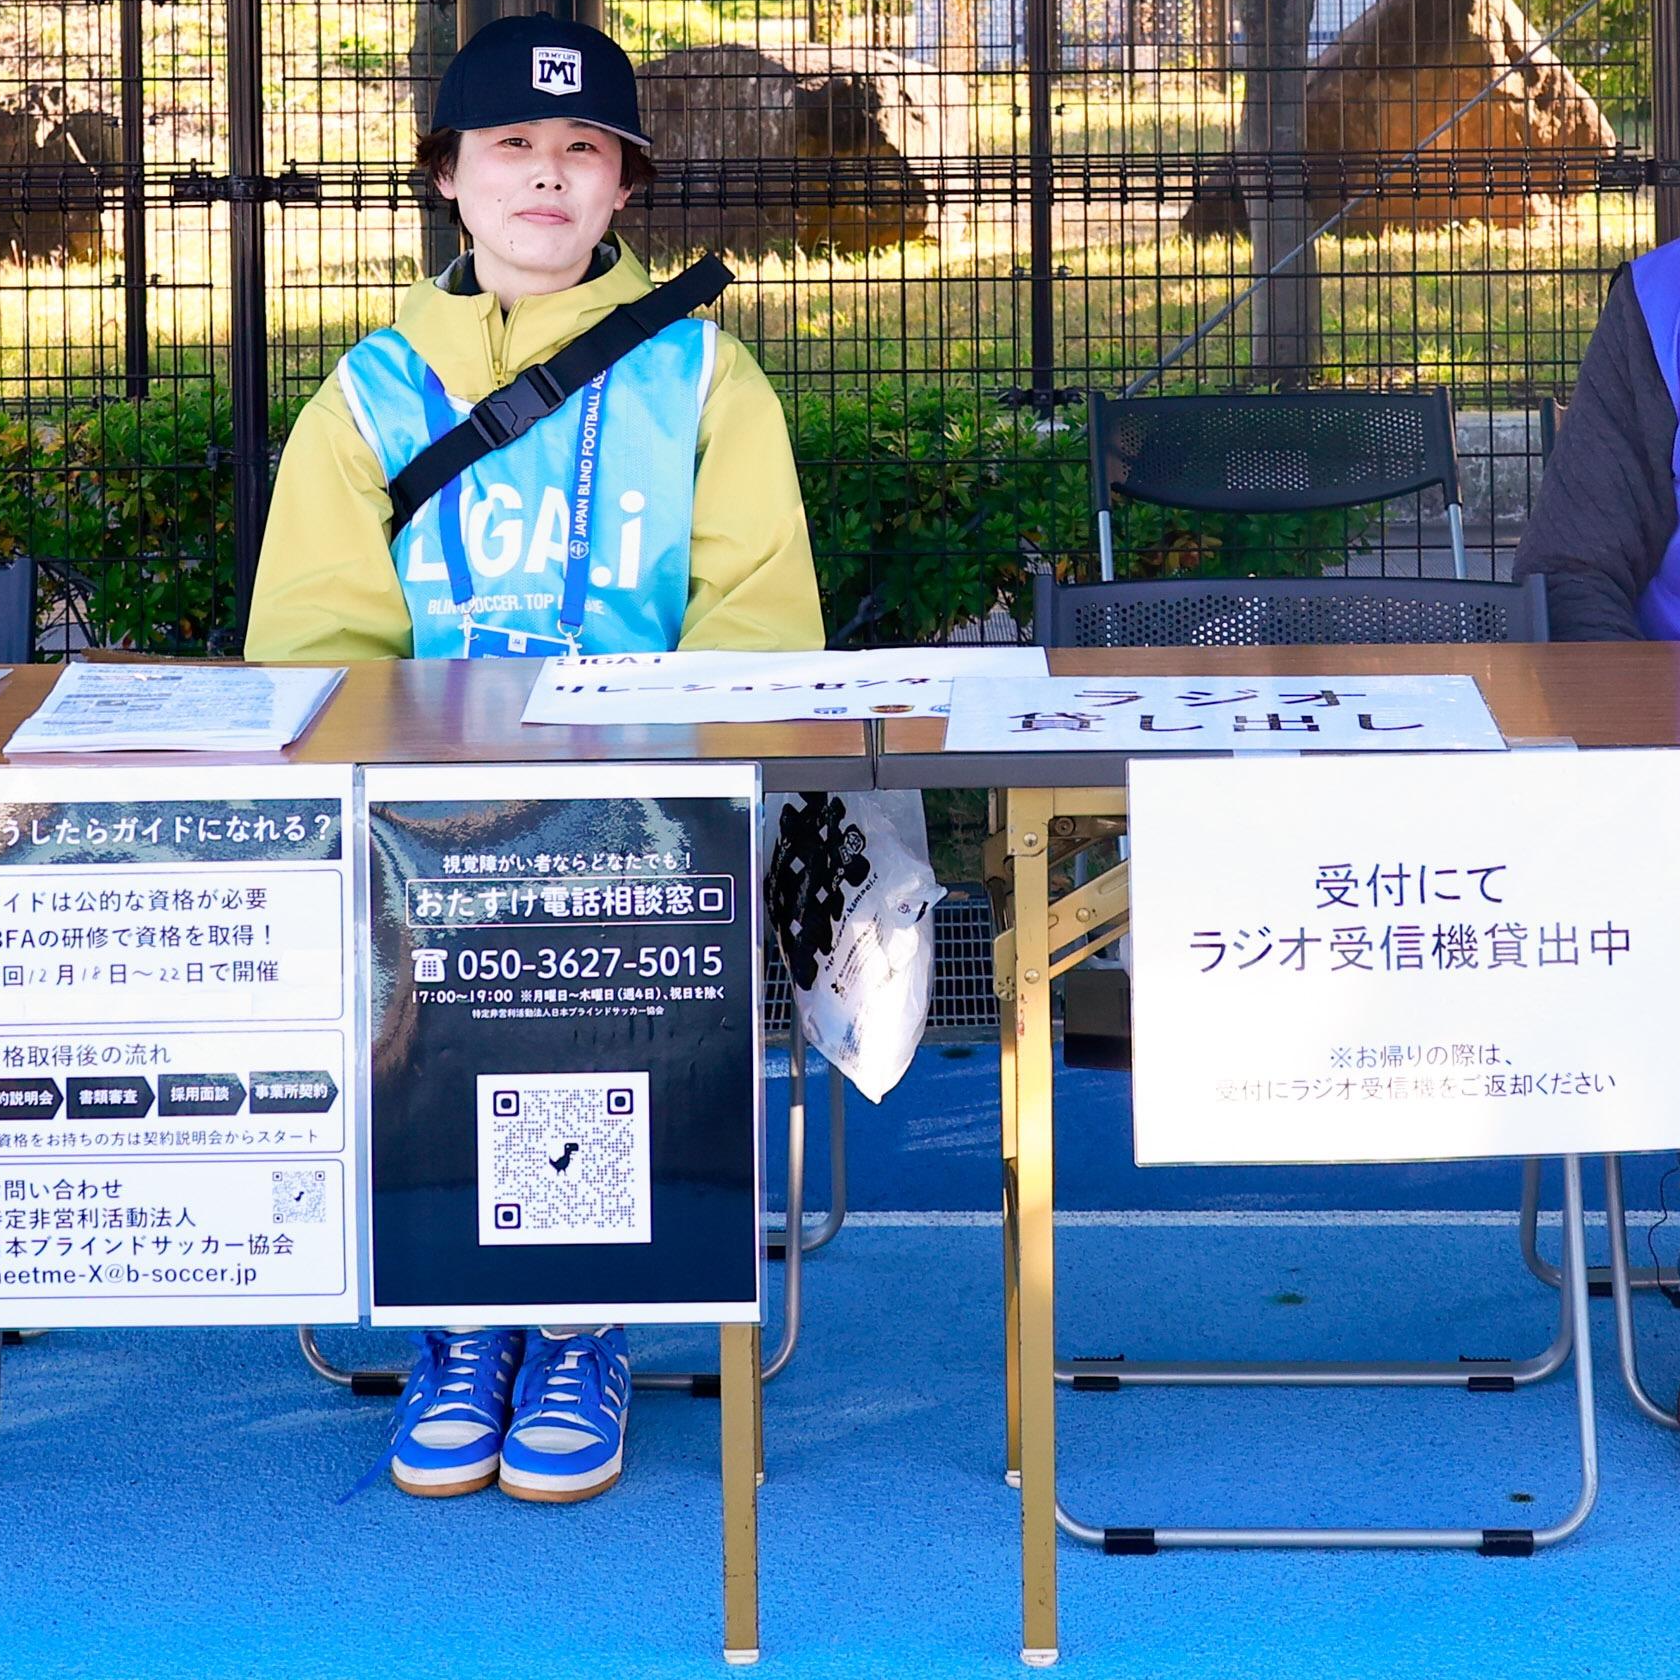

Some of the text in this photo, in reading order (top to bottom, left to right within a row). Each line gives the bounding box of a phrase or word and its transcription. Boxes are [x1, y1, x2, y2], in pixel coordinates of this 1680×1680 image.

[580, 392, 600, 456] FOOTBALL
[577, 458, 593, 496] BLIND
[574, 498, 589, 537] JAPAN
[524, 593, 554, 610] TOP
[1074, 688, 1367, 707] ラジオ
[1009, 711, 1424, 734] 貸し出し
[415, 886, 725, 919] おたすけ電話相談窓口
[1315, 862, 1509, 910] 受付にて
[458, 945, 723, 981] 050-3627-5015
[1188, 921, 1632, 973] ラジオ受信機貸出中
[78, 1088, 138, 1106] 書類審査
[170, 1085, 230, 1103] 採用面談
[255, 1082, 328, 1101] 事業所契約
[1215, 1072, 1617, 1103] 受付にラジオ受信機をご返却ください
